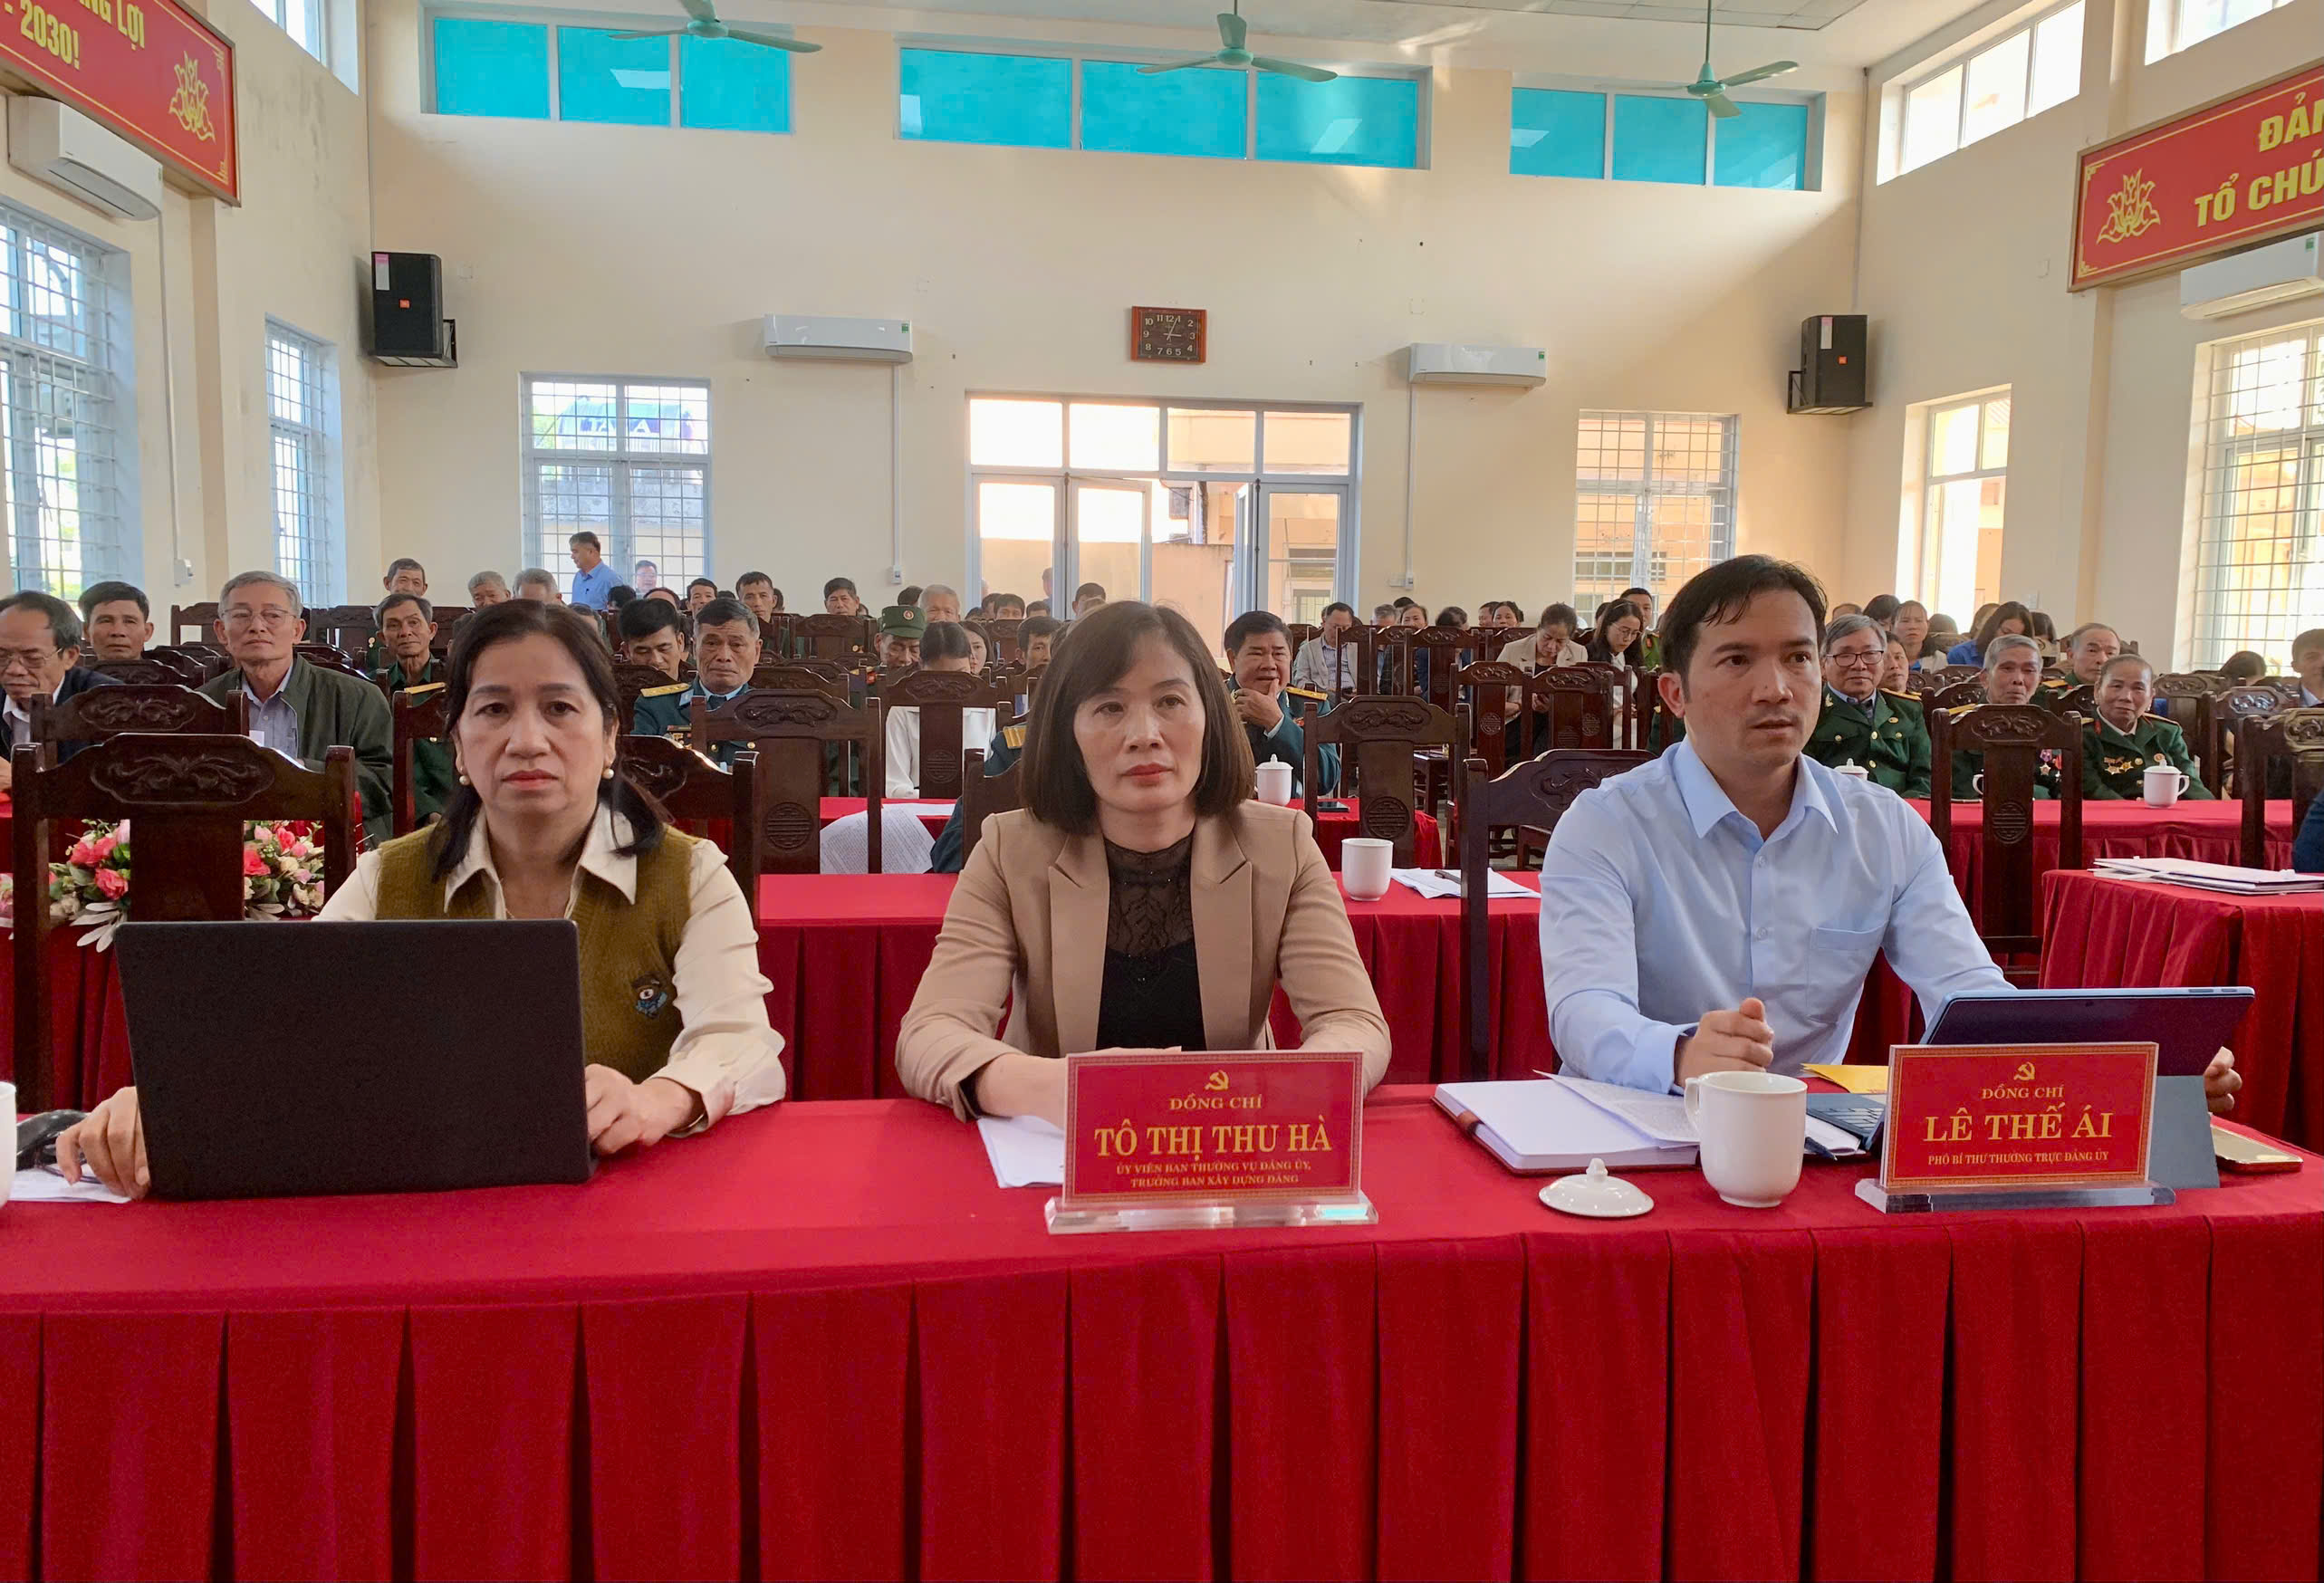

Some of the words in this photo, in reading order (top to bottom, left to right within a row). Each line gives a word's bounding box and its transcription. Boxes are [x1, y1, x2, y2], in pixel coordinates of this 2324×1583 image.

[20, 0, 81, 70] 2030!
[2194, 172, 2240, 227] TỔ
[1145, 318, 1154, 326] 10
[1157, 314, 1164, 322] 11
[1166, 314, 1175, 322] 12
[1143, 330, 1149, 338] 9
[1175, 348, 1181, 356] 5
[2034, 1084, 2064, 1099] CHÍ
[1229, 1094, 1263, 1109] CHÍ
[1923, 1107, 1973, 1141] LÊ
[1984, 1102, 2065, 1140] THẾ
[2070, 1104, 2115, 1138] ÁI
[1094, 1118, 1138, 1156] TÔ
[1147, 1126, 1203, 1161] THỊ
[1212, 1124, 1279, 1154] THU
[1288, 1114, 1332, 1153] HÀ
[1927, 1152, 1950, 1166] PHÓ
[1952, 1151, 1964, 1165] BÍ
[1964, 1153, 1988, 1165] THƯ
[2034, 1151, 2063, 1165] TRỰC
[1165, 1163, 1188, 1173] BAN
